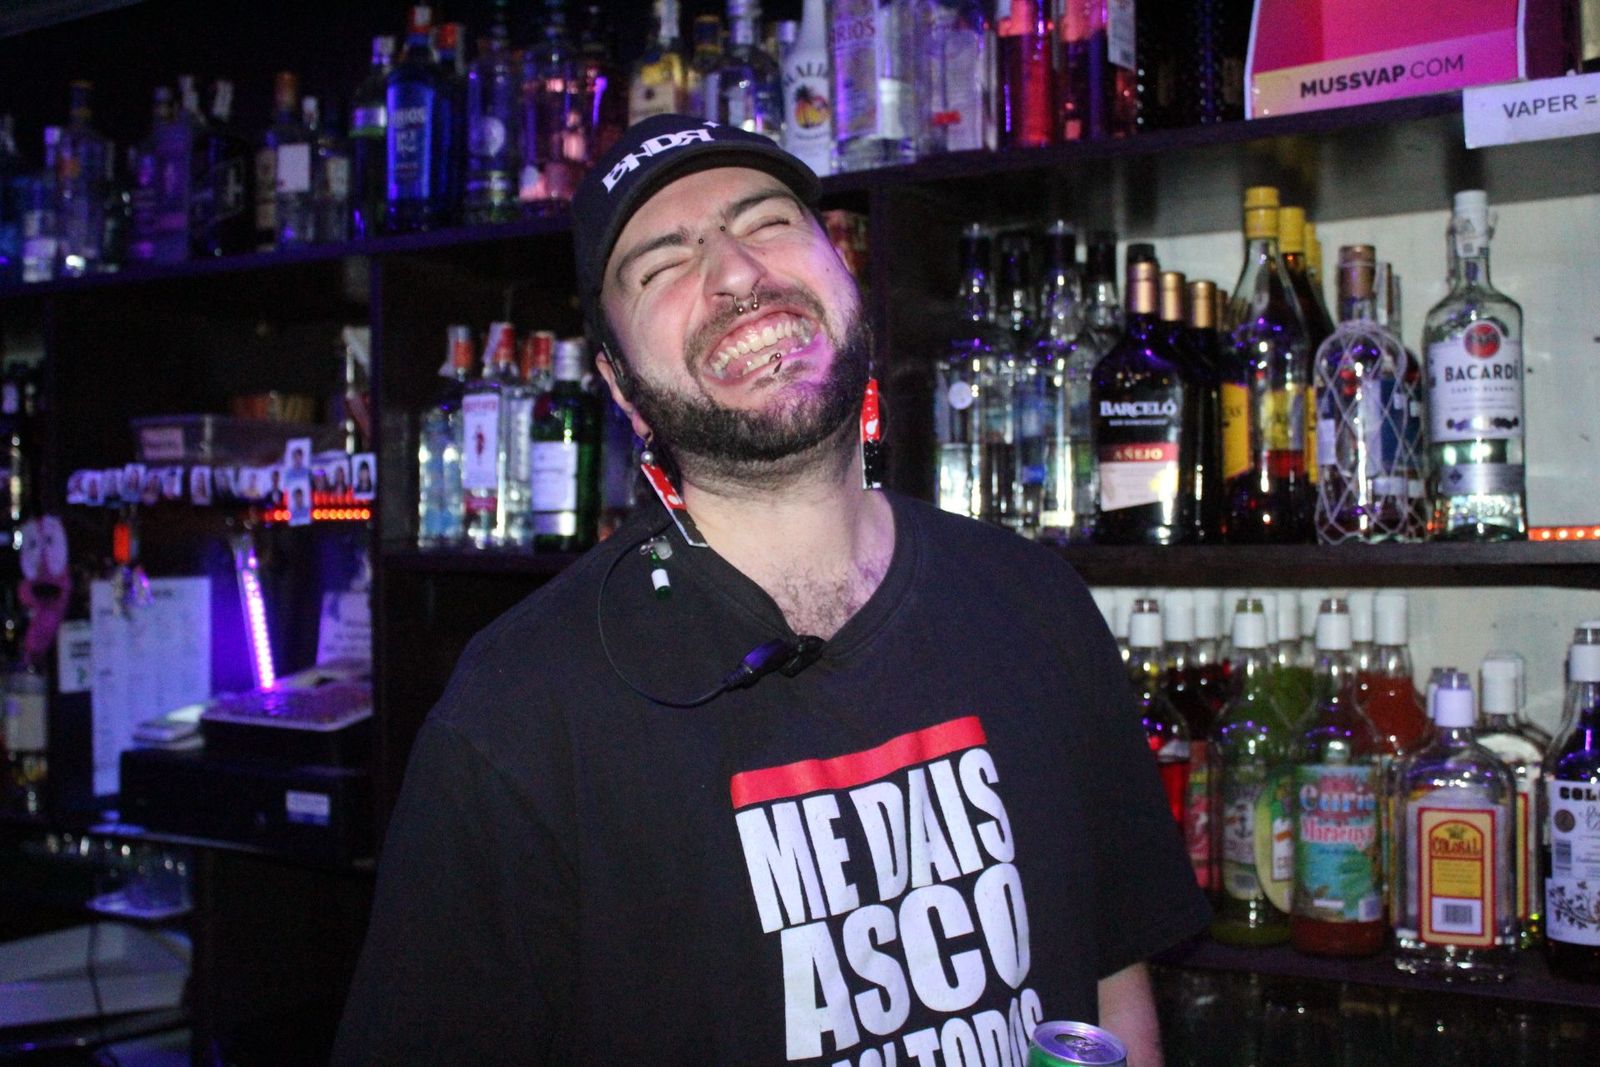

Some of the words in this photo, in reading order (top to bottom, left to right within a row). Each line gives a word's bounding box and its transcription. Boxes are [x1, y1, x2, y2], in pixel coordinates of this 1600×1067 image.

[1503, 94, 1577, 119] VAPER
[735, 794, 860, 934] ME
[849, 748, 1015, 901] DAIS
[781, 863, 1032, 1061] ASCO
